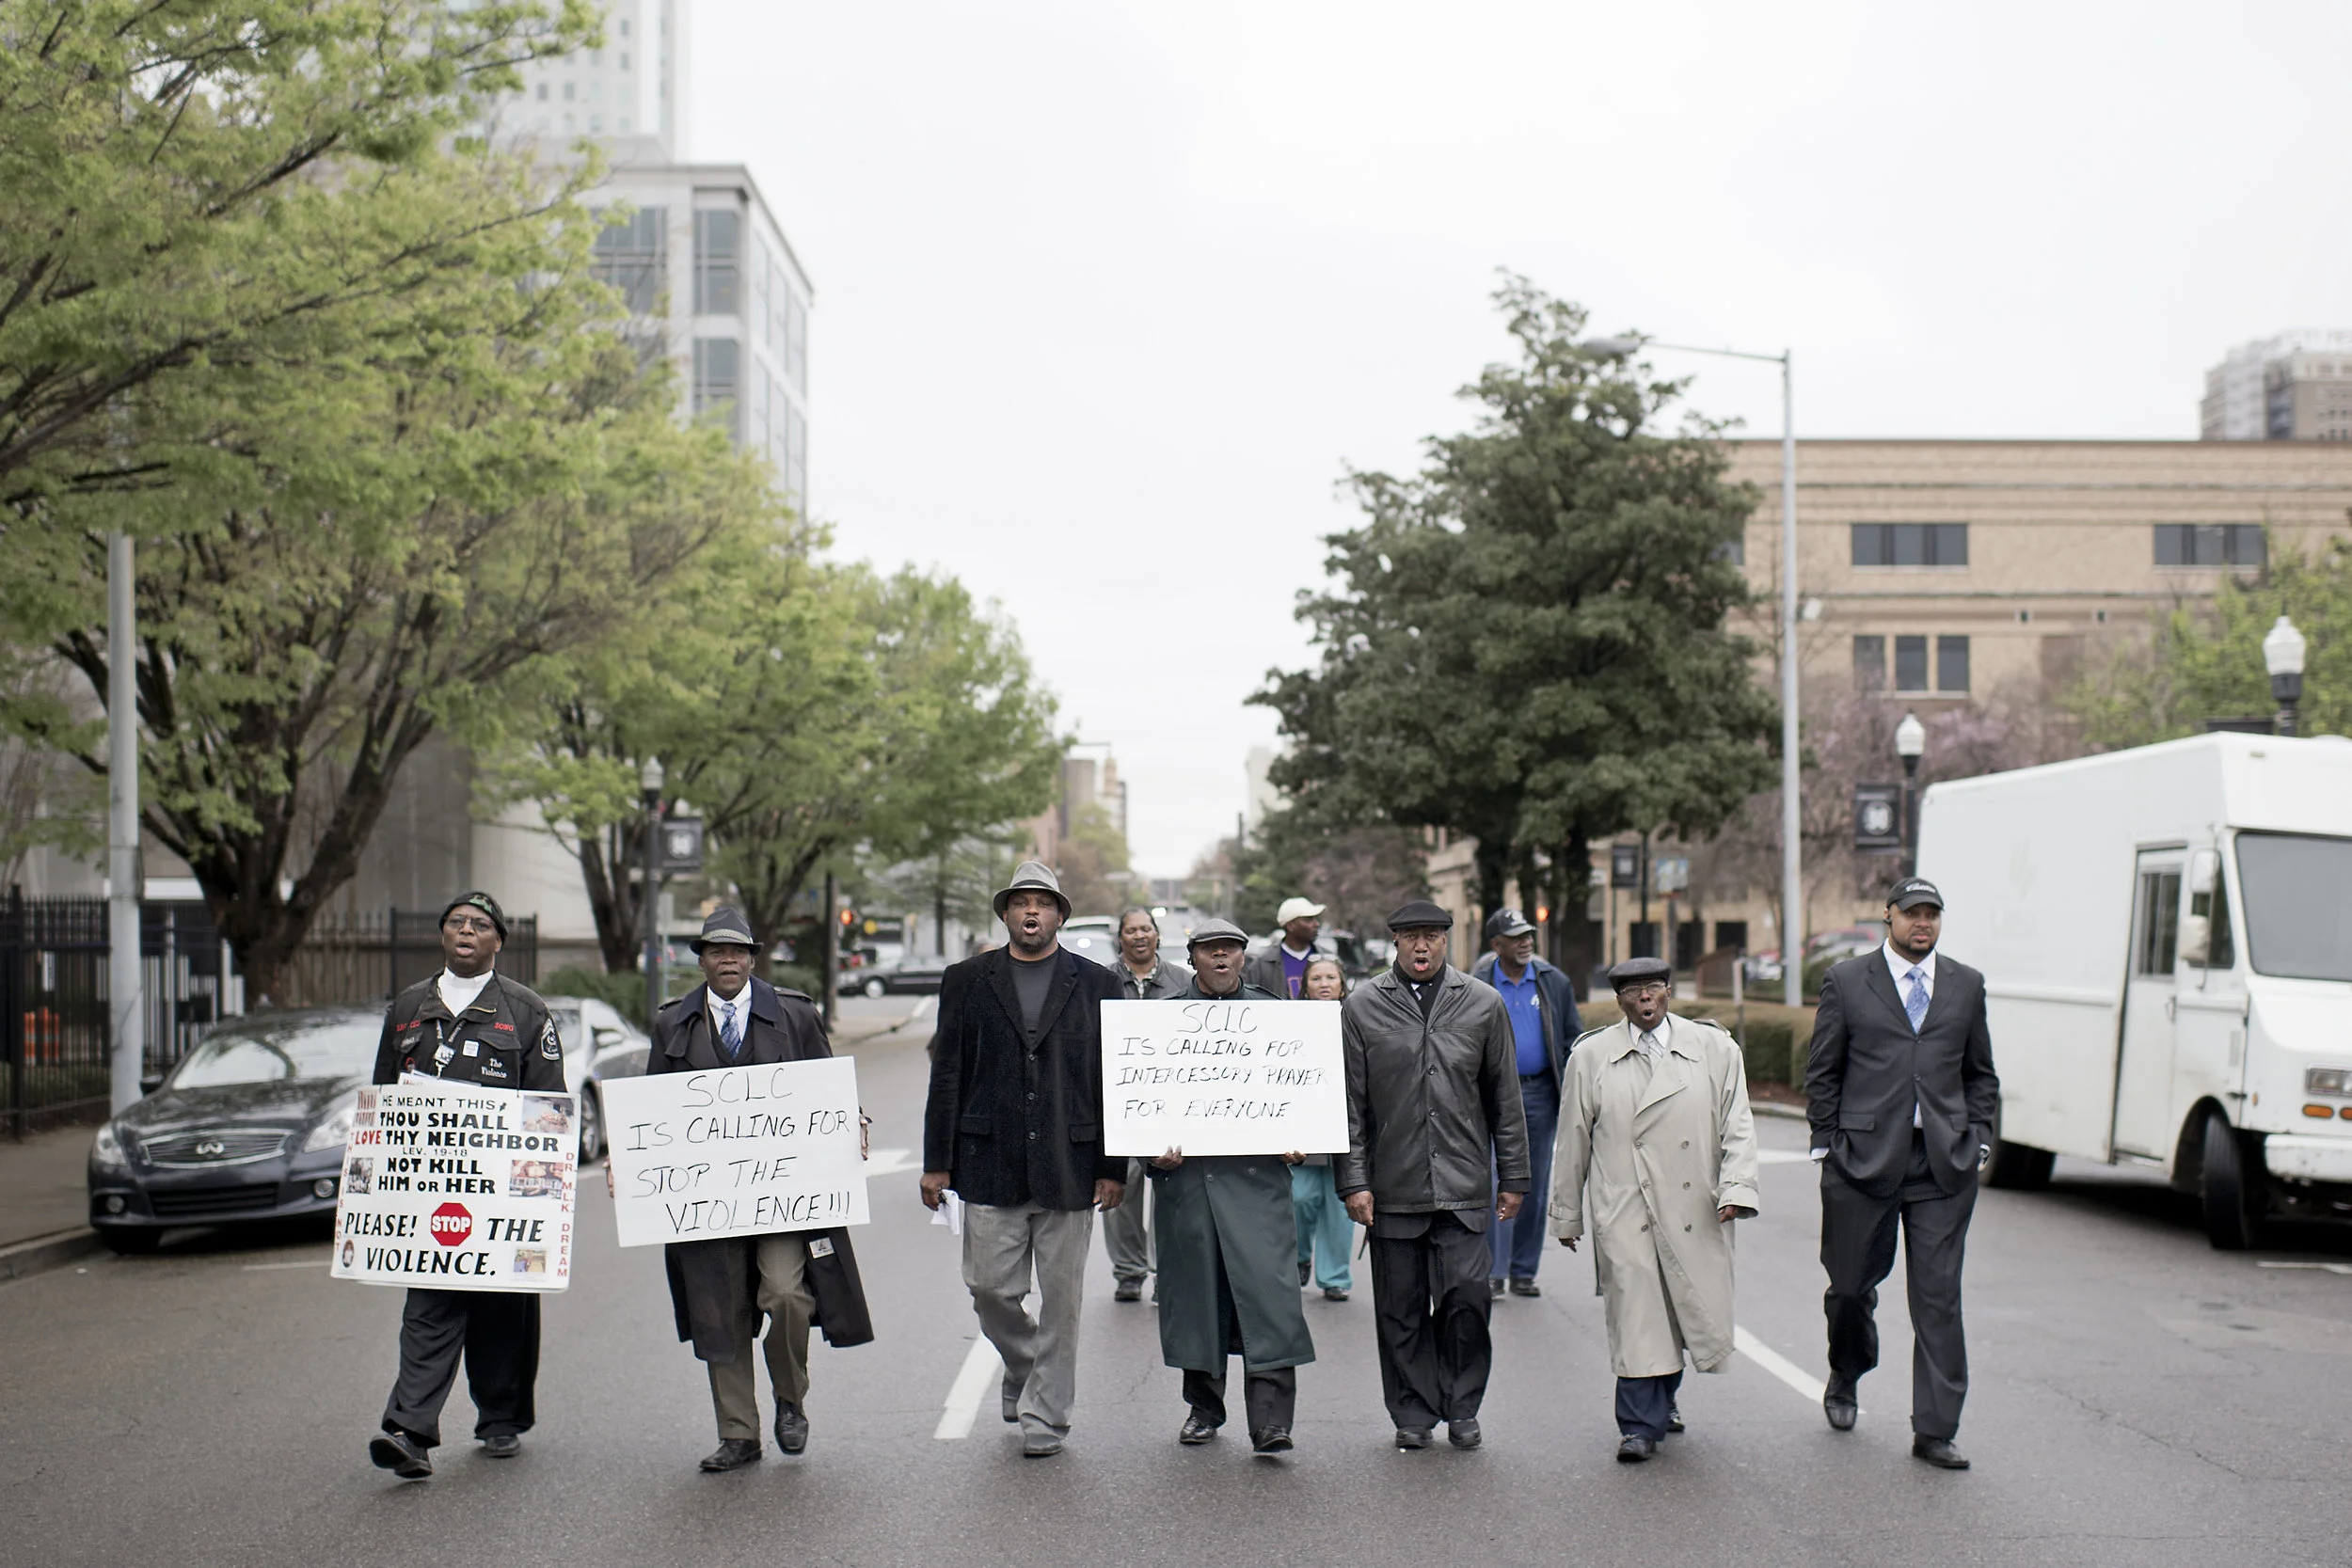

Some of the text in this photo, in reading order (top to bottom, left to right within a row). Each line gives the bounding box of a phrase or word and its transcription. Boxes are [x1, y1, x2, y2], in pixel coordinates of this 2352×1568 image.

[1177, 1003, 1258, 1034] SCLC
[1118, 1037, 1306, 1057] IS CALLING FOR
[481, 1066, 508, 1079] Violence
[489, 1057, 503, 1069] The
[1116, 1065, 1328, 1086] INTERCESSORY PRAYER
[682, 1067, 793, 1108] SCLC
[382, 1095, 392, 1107] HE
[397, 1097, 446, 1108] MEANT
[456, 1098, 496, 1110] THIS
[1123, 1098, 1291, 1118] FOR EVERYONE
[380, 1112, 421, 1128] THOU
[427, 1112, 509, 1131] SHALL
[627, 1110, 850, 1151] IS CALLING FOR
[355, 1130, 560, 1152] LOVE THY NEIGHBOR
[402, 1148, 469, 1158] LEV. 19-18
[387, 1157, 483, 1175] NOT KILL
[378, 1176, 410, 1192] HIM
[445, 1178, 496, 1195] HER
[631, 1156, 798, 1198] STOP THE
[344, 1212, 546, 1243] PLEASE! STOP THE
[557, 1223, 571, 1277] DREAM
[366, 1246, 497, 1276] VIOLENCE.
